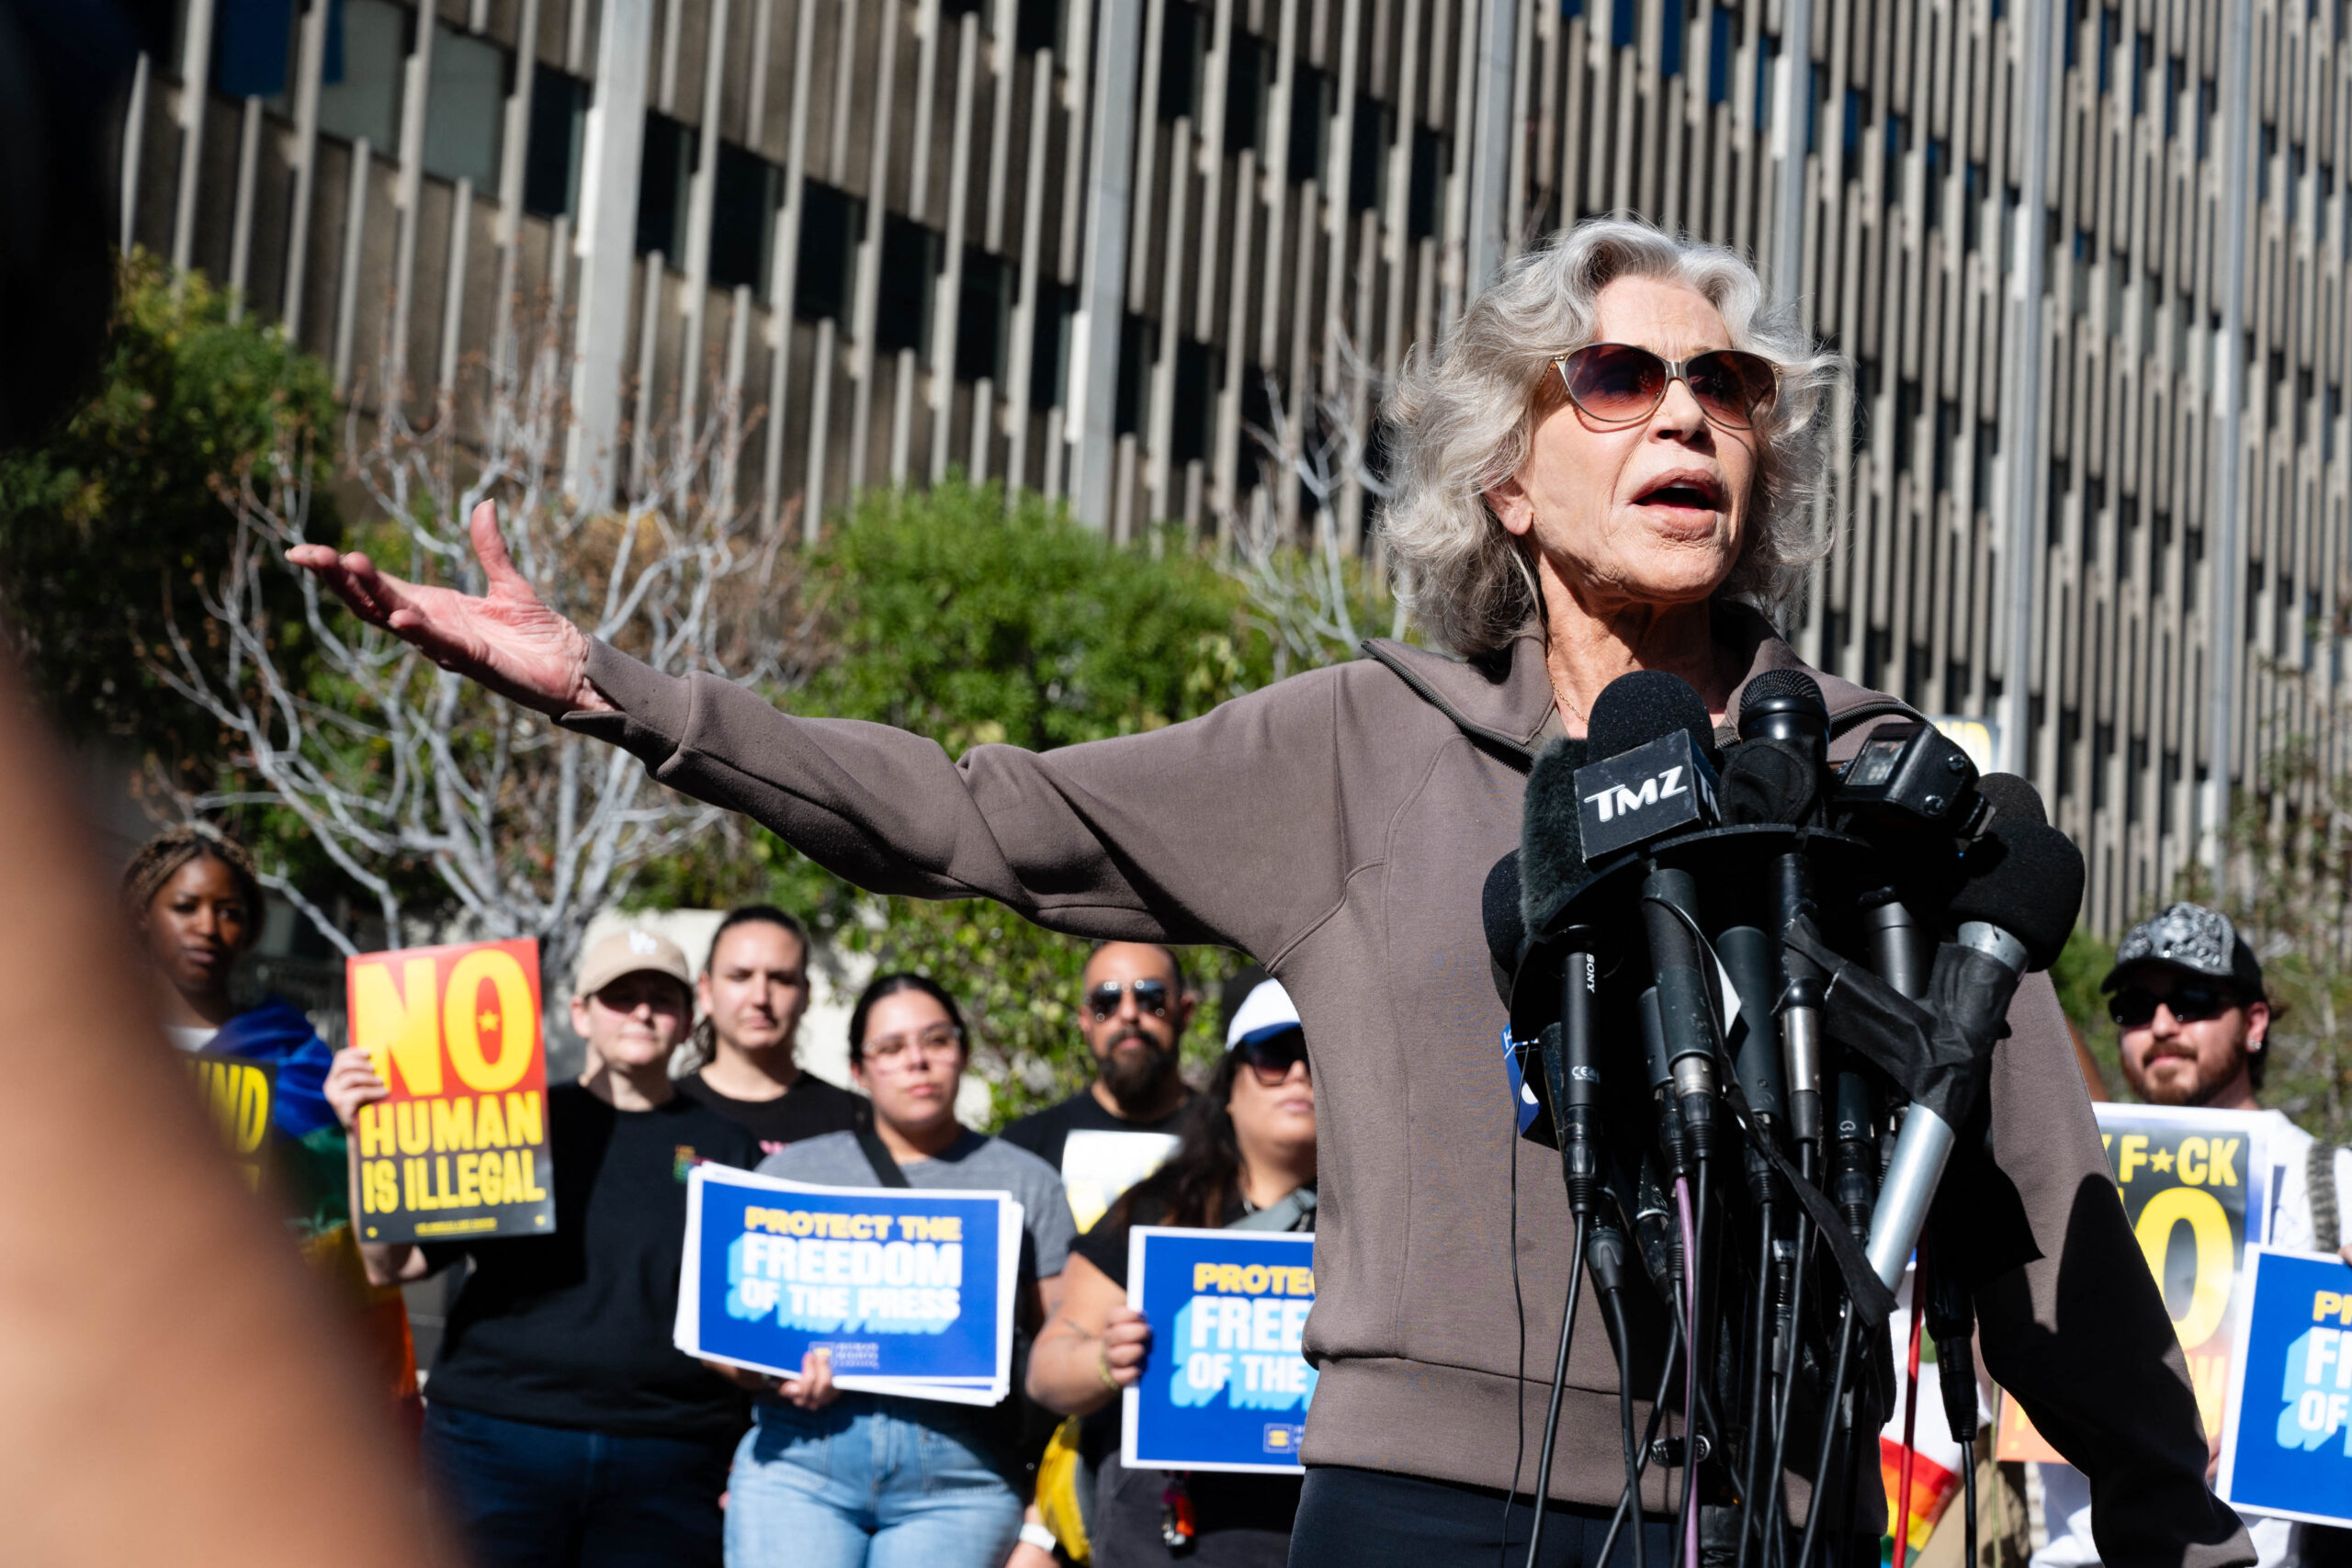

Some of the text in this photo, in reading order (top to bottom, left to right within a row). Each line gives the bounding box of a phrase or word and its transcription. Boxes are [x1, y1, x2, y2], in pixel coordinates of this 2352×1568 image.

[1584, 765, 1688, 822] TMZ
[1586, 953, 1595, 994] SONY
[354, 948, 536, 1097] NO
[358, 1090, 544, 1157] HUMAN
[360, 1148, 547, 1213] IS ILLEGAL
[744, 1205, 963, 1241] PROTECT THE
[741, 1231, 963, 1288] FREEDOM
[1193, 1262, 1316, 1296] PROTE
[2117, 1187, 2234, 1350] O
[740, 1277, 961, 1320] OF THE PRESS
[1187, 1352, 1307, 1393] OF THE
[2298, 1389, 2350, 1435] OF
